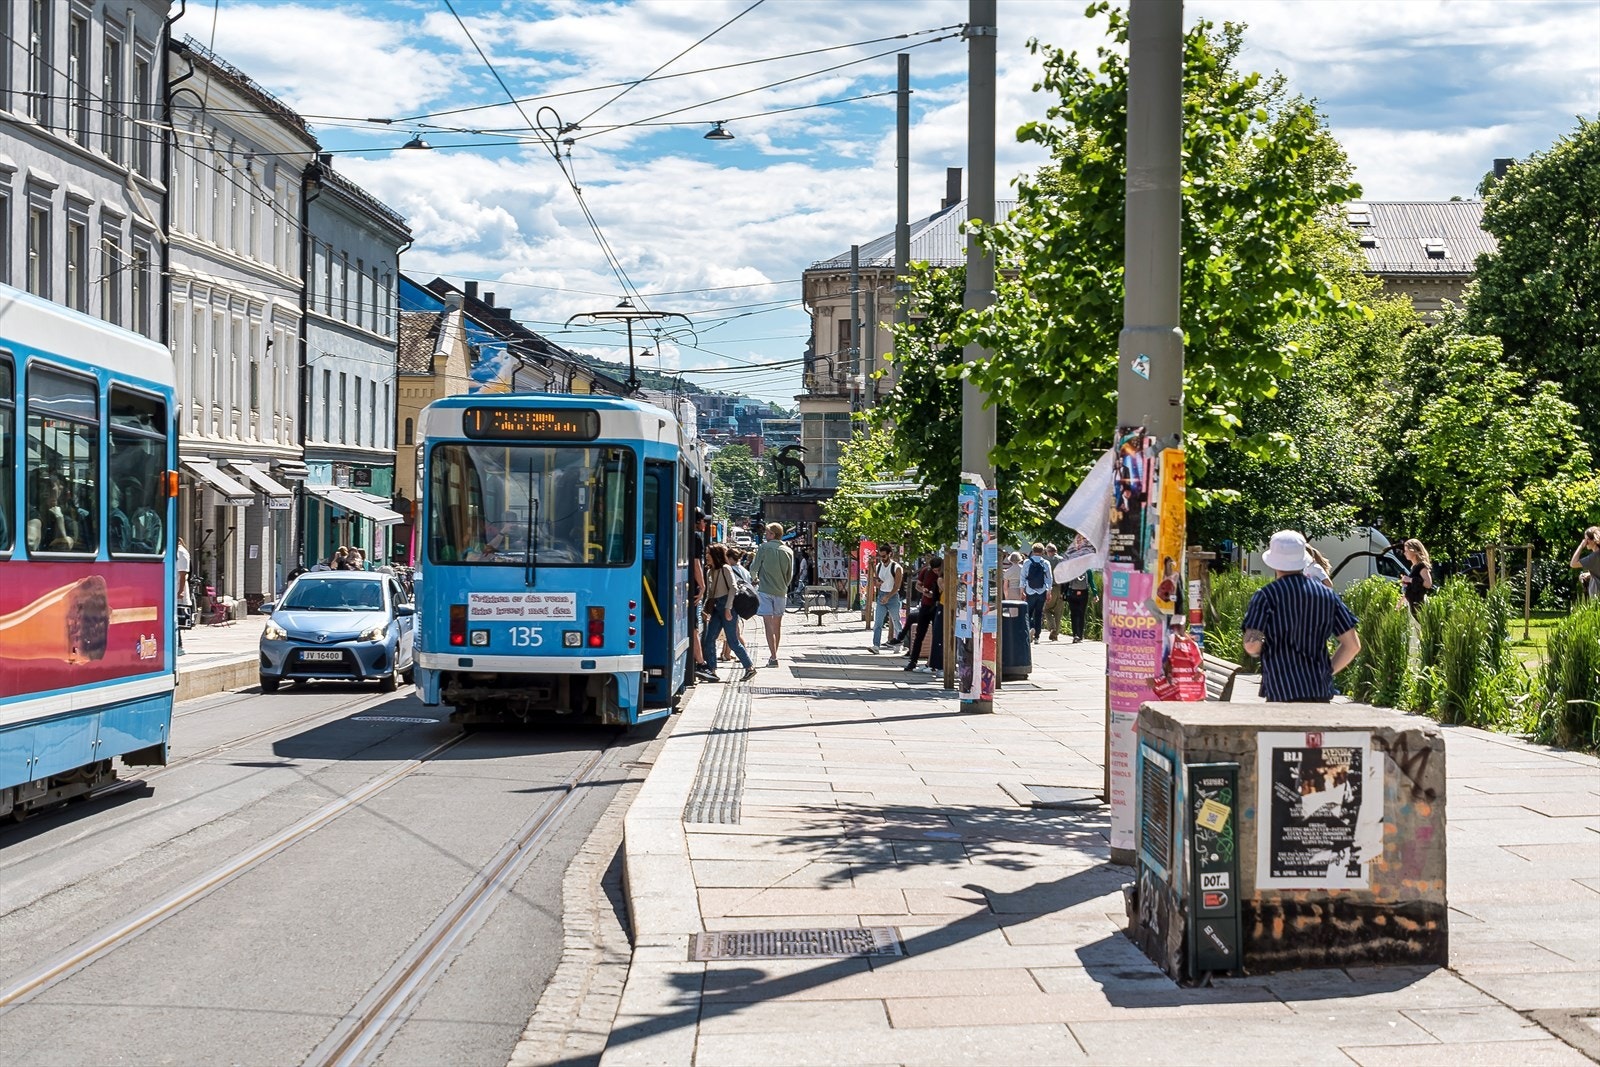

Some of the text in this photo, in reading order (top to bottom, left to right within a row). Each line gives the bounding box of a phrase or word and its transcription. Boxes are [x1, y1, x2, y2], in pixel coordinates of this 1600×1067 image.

[528, 606, 549, 615] med
[553, 606, 572, 615] den
[1110, 614, 1157, 629] KSOPP
[508, 626, 544, 647] 135
[1118, 629, 1156, 640] JONES
[1126, 646, 1156, 654] POWER
[305, 652, 340, 660] JV 16400
